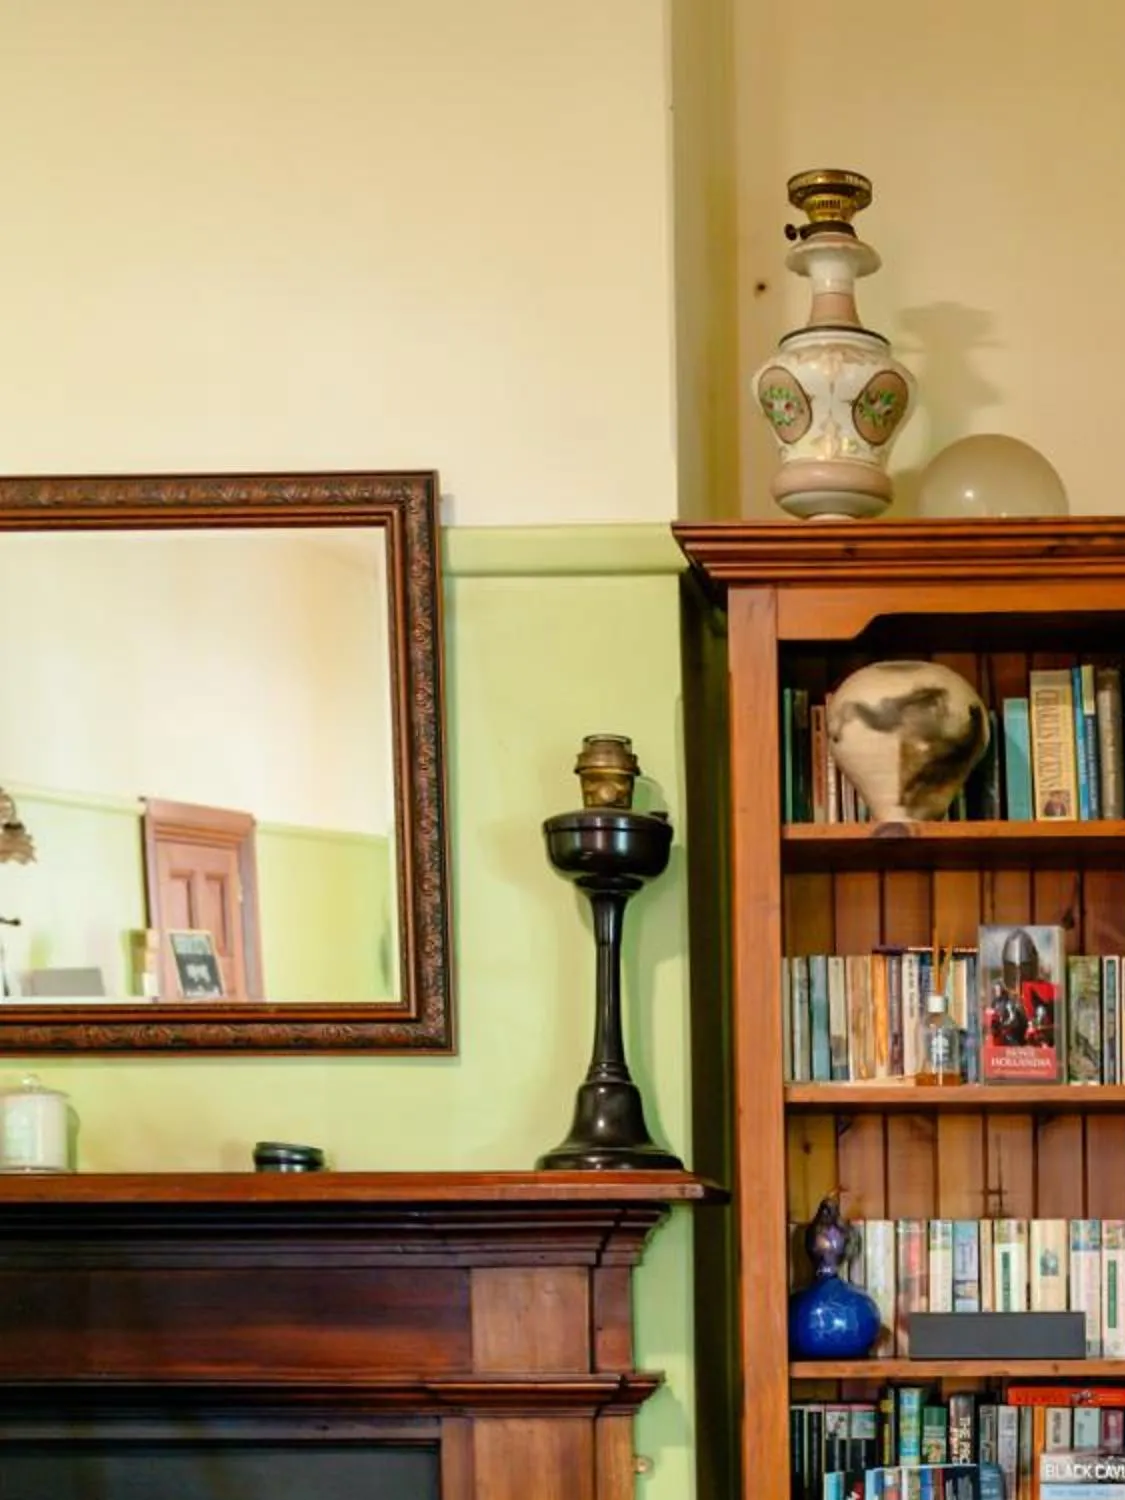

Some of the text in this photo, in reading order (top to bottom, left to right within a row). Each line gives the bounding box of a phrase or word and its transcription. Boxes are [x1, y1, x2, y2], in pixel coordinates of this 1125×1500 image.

[959, 1417, 971, 1464] THE PRO
[1045, 1463, 1091, 1479] BLACK
